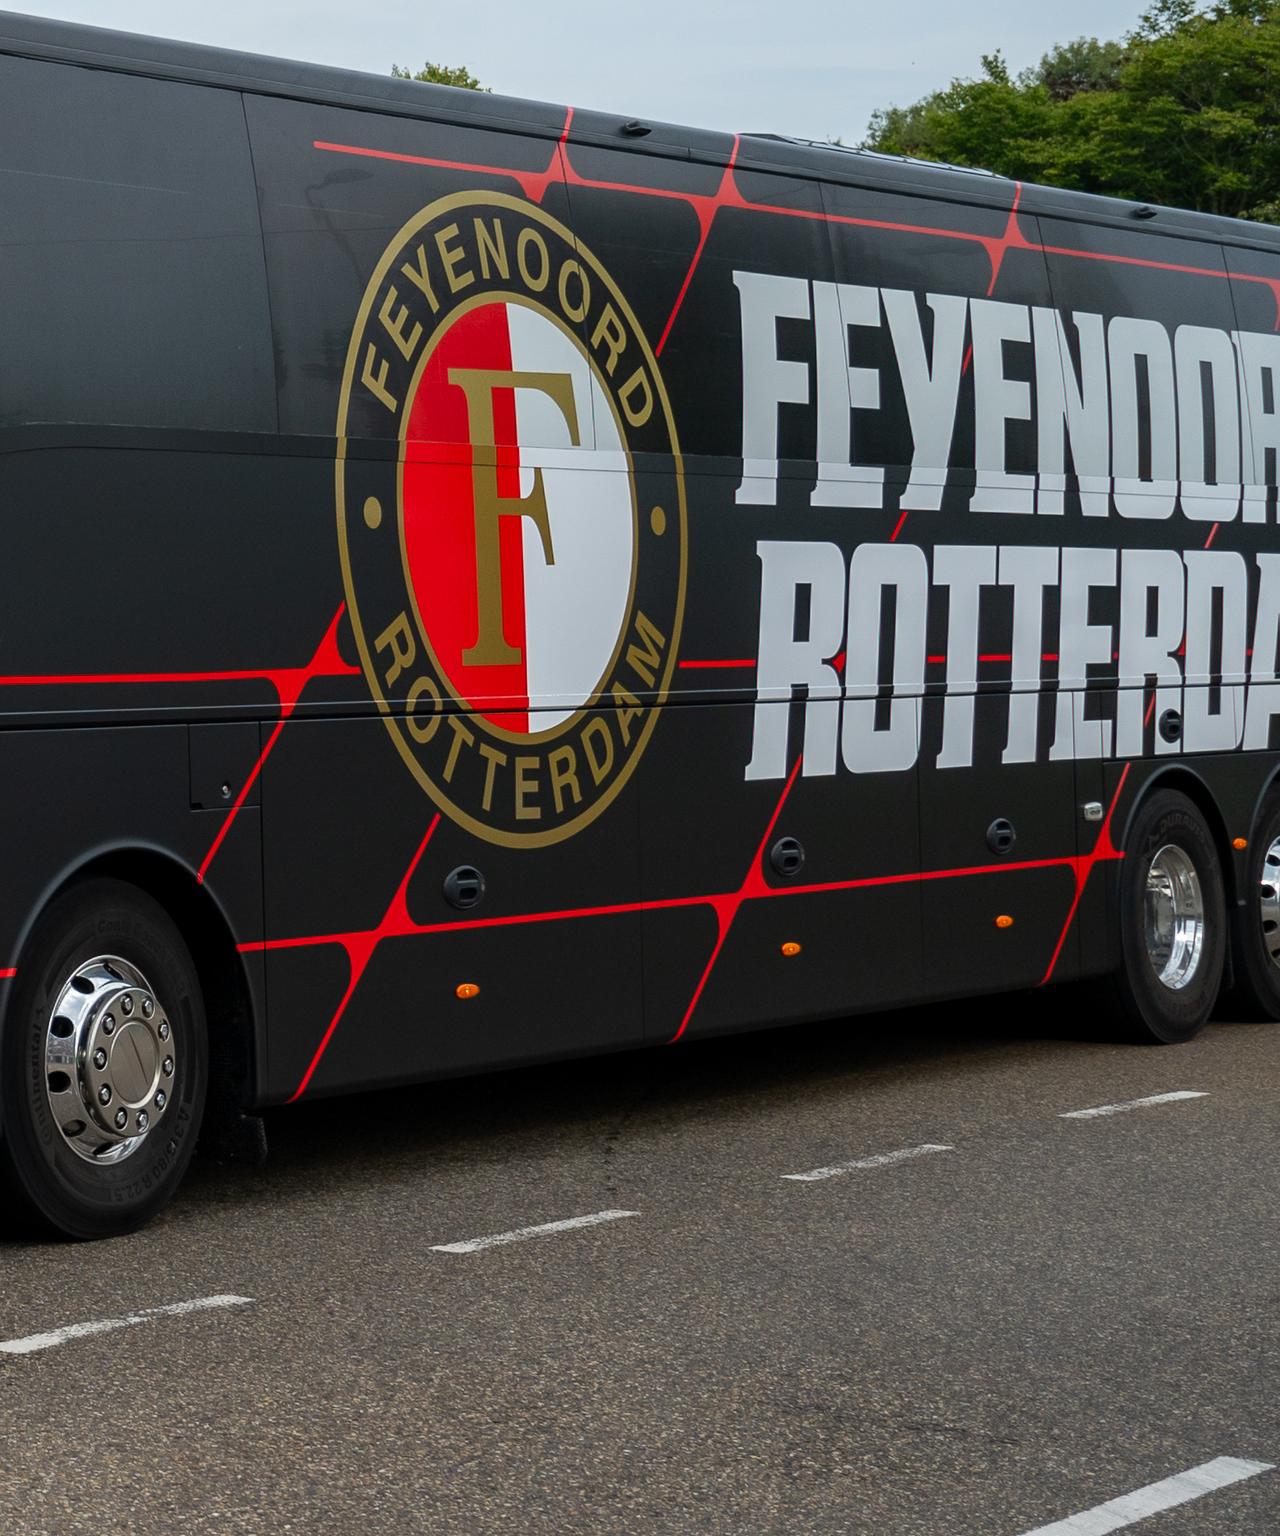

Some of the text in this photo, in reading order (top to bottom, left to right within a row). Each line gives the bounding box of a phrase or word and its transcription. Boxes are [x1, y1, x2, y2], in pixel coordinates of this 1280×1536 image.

[361, 217, 654, 428] FEYENOORD
[446, 367, 581, 667] F
[374, 610, 666, 820] ROTTERDAM
